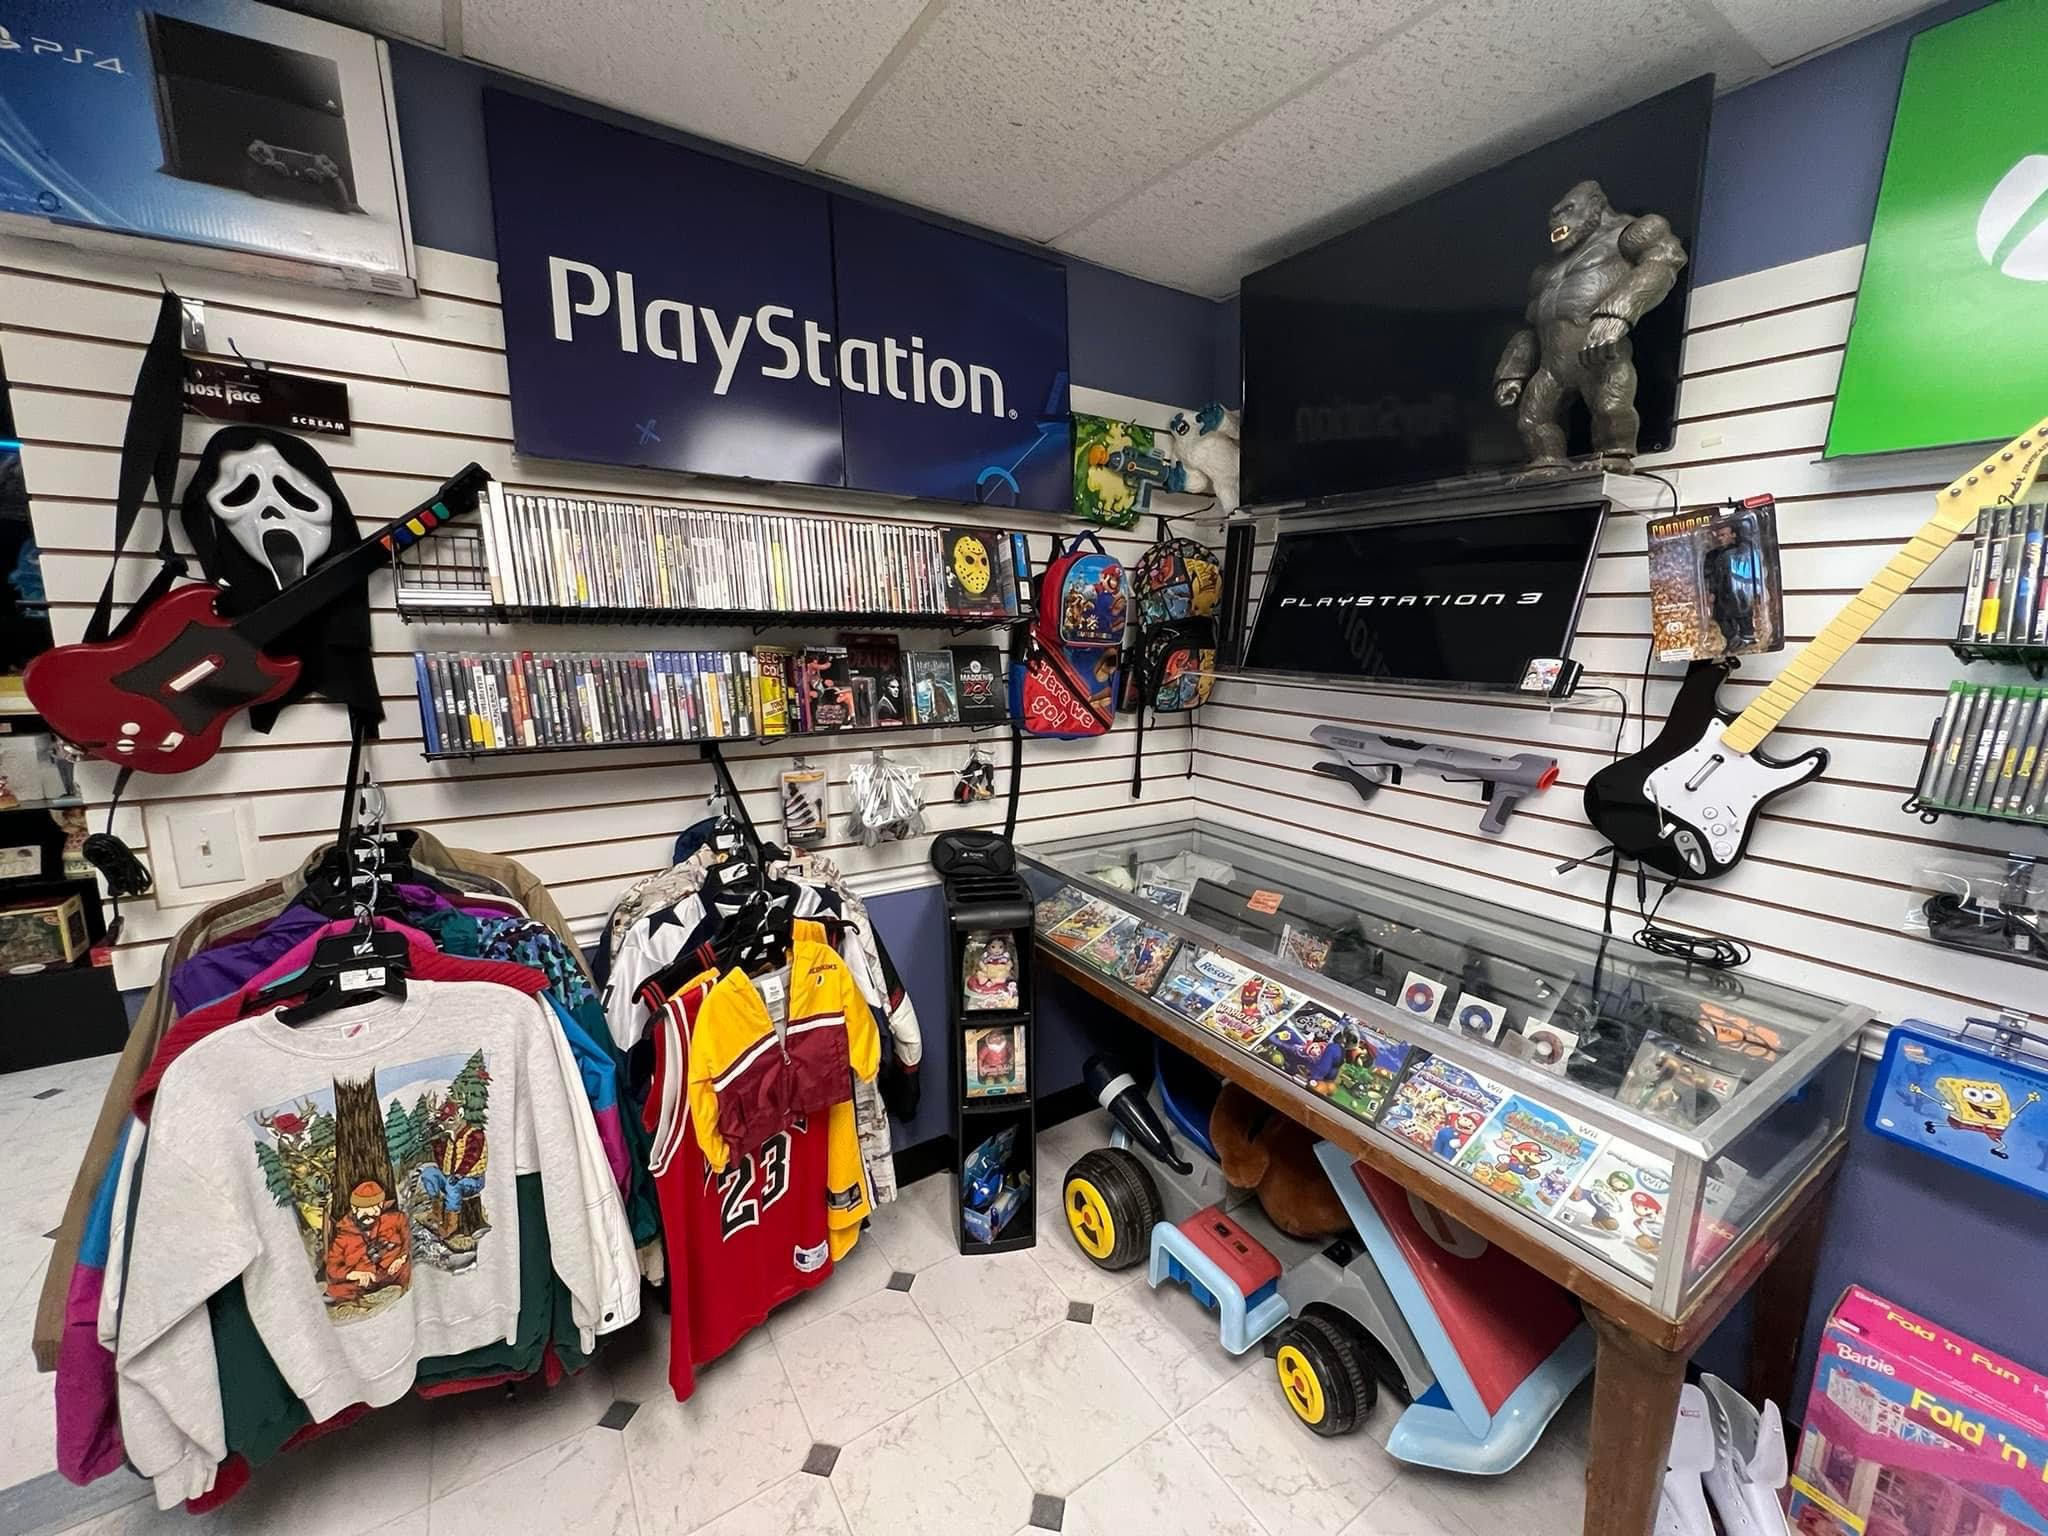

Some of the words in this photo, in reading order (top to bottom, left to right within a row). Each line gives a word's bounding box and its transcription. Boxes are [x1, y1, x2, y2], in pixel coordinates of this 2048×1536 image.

[31, 36, 125, 74] PS4
[183, 379, 224, 399] host
[291, 416, 345, 430] SCREAM
[1280, 593, 1506, 608] PLAYSTATION
[1515, 592, 1544, 605] 3
[1031, 695, 1068, 728] go!
[1199, 961, 1236, 982] Resort
[1486, 1081, 1505, 1095] Wii
[1578, 1125, 1599, 1139] Wii
[716, 1130, 792, 1243] 23
[1642, 1174, 1665, 1189] Wii
[1886, 1310, 1937, 1342] Fold
[1971, 1352, 2021, 1385] Fun
[1835, 1341, 1896, 1377] Barbie
[1910, 1387, 1986, 1447] Fold
[1998, 1433, 2028, 1470] 'n
